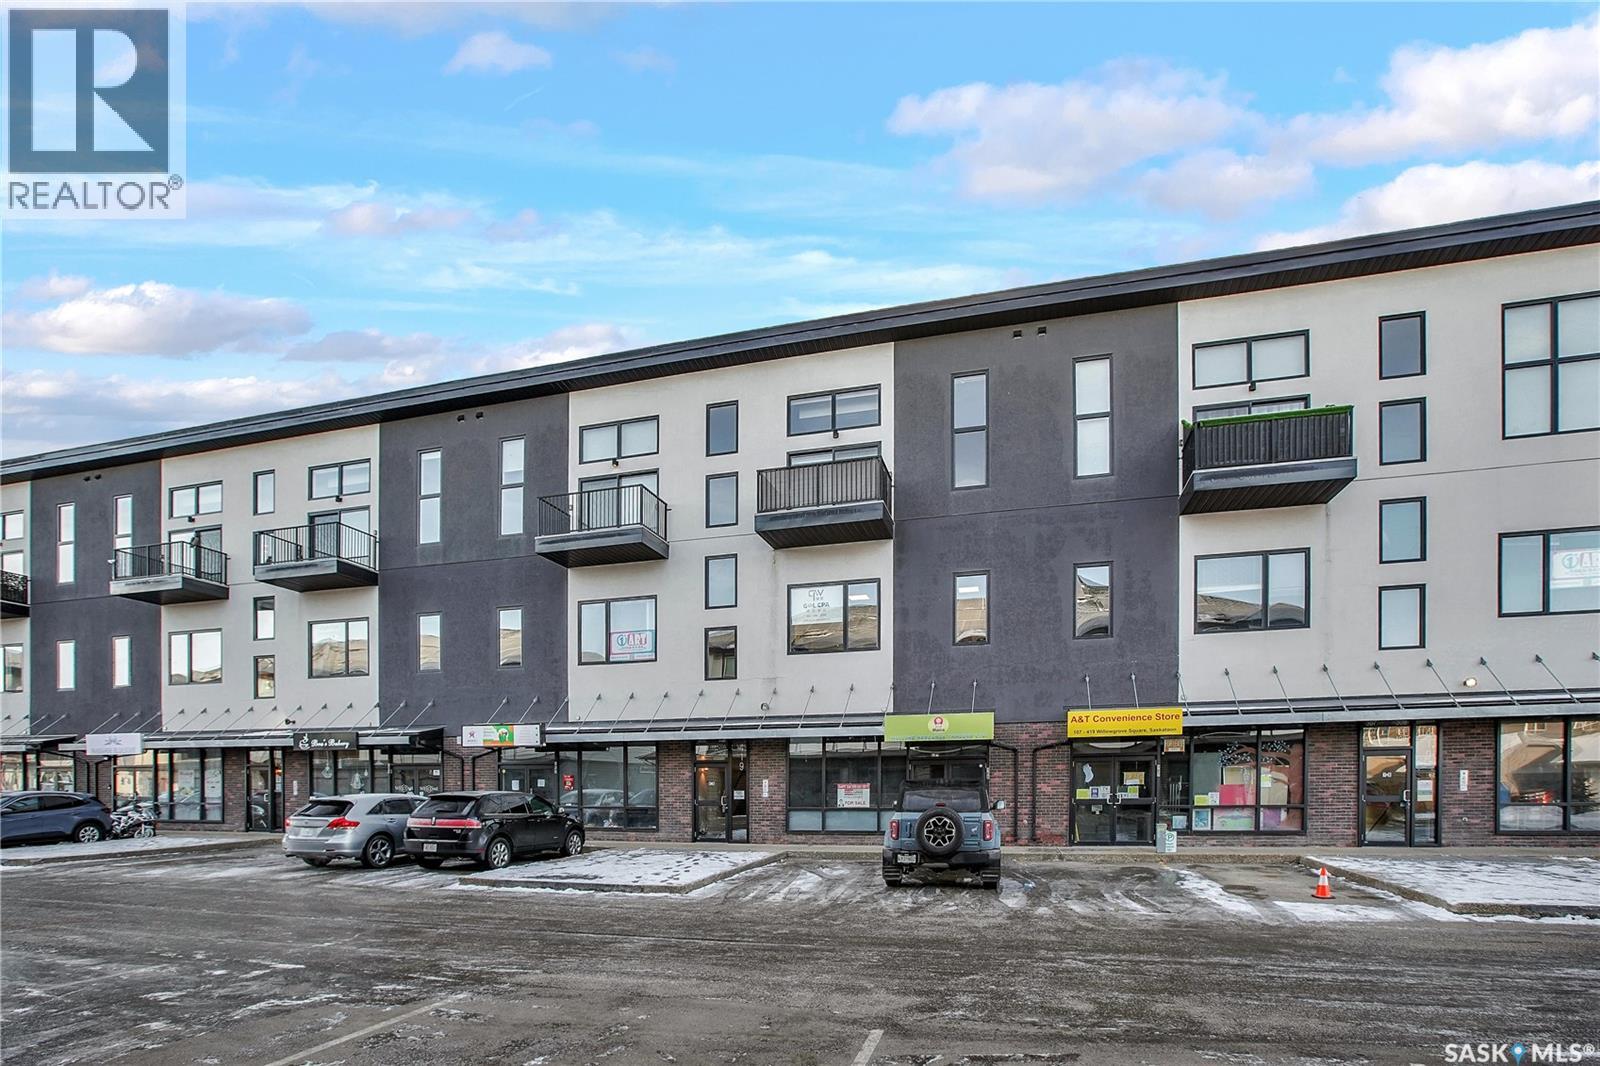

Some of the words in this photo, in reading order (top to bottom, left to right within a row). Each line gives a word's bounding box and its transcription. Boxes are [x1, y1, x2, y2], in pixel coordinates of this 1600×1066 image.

[1070, 715, 1090, 724] A&T
[1093, 714, 1153, 723] Convenience
[1155, 712, 1180, 721] Store
